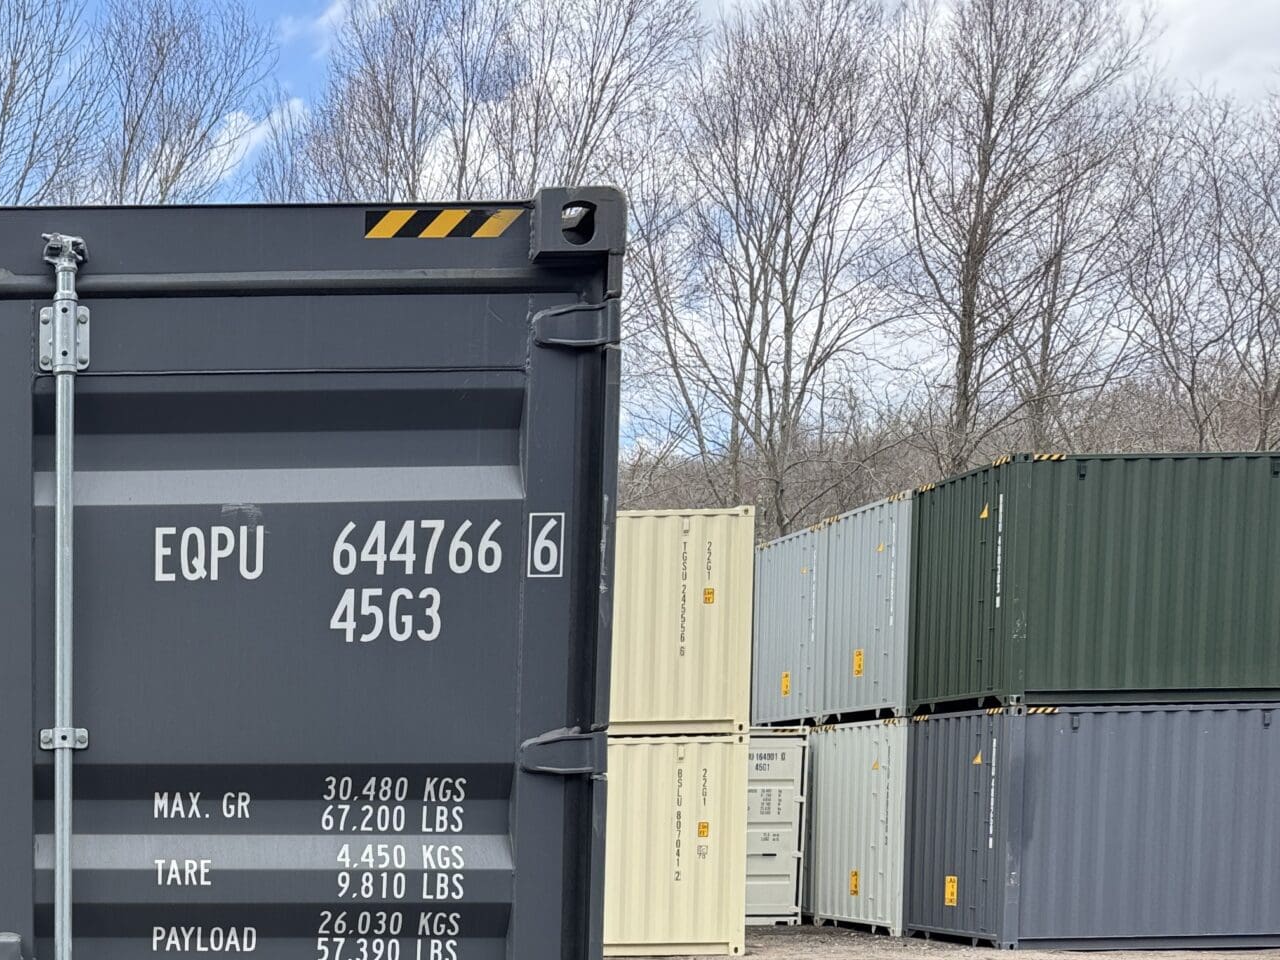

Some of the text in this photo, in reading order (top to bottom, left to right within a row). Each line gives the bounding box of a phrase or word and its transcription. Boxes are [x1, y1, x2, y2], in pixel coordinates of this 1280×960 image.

[155, 517, 558, 581] EQPU 644766 6
[330, 587, 442, 642] 45G3
[423, 777, 467, 802] KGS
[153, 792, 251, 818] MAX. GR
[422, 805, 464, 832] LBS
[422, 844, 465, 869] KGS
[154, 859, 212, 885] TARE
[422, 873, 464, 900] LBS
[418, 912, 461, 936] KGS
[152, 926, 257, 952] PAYLOAD
